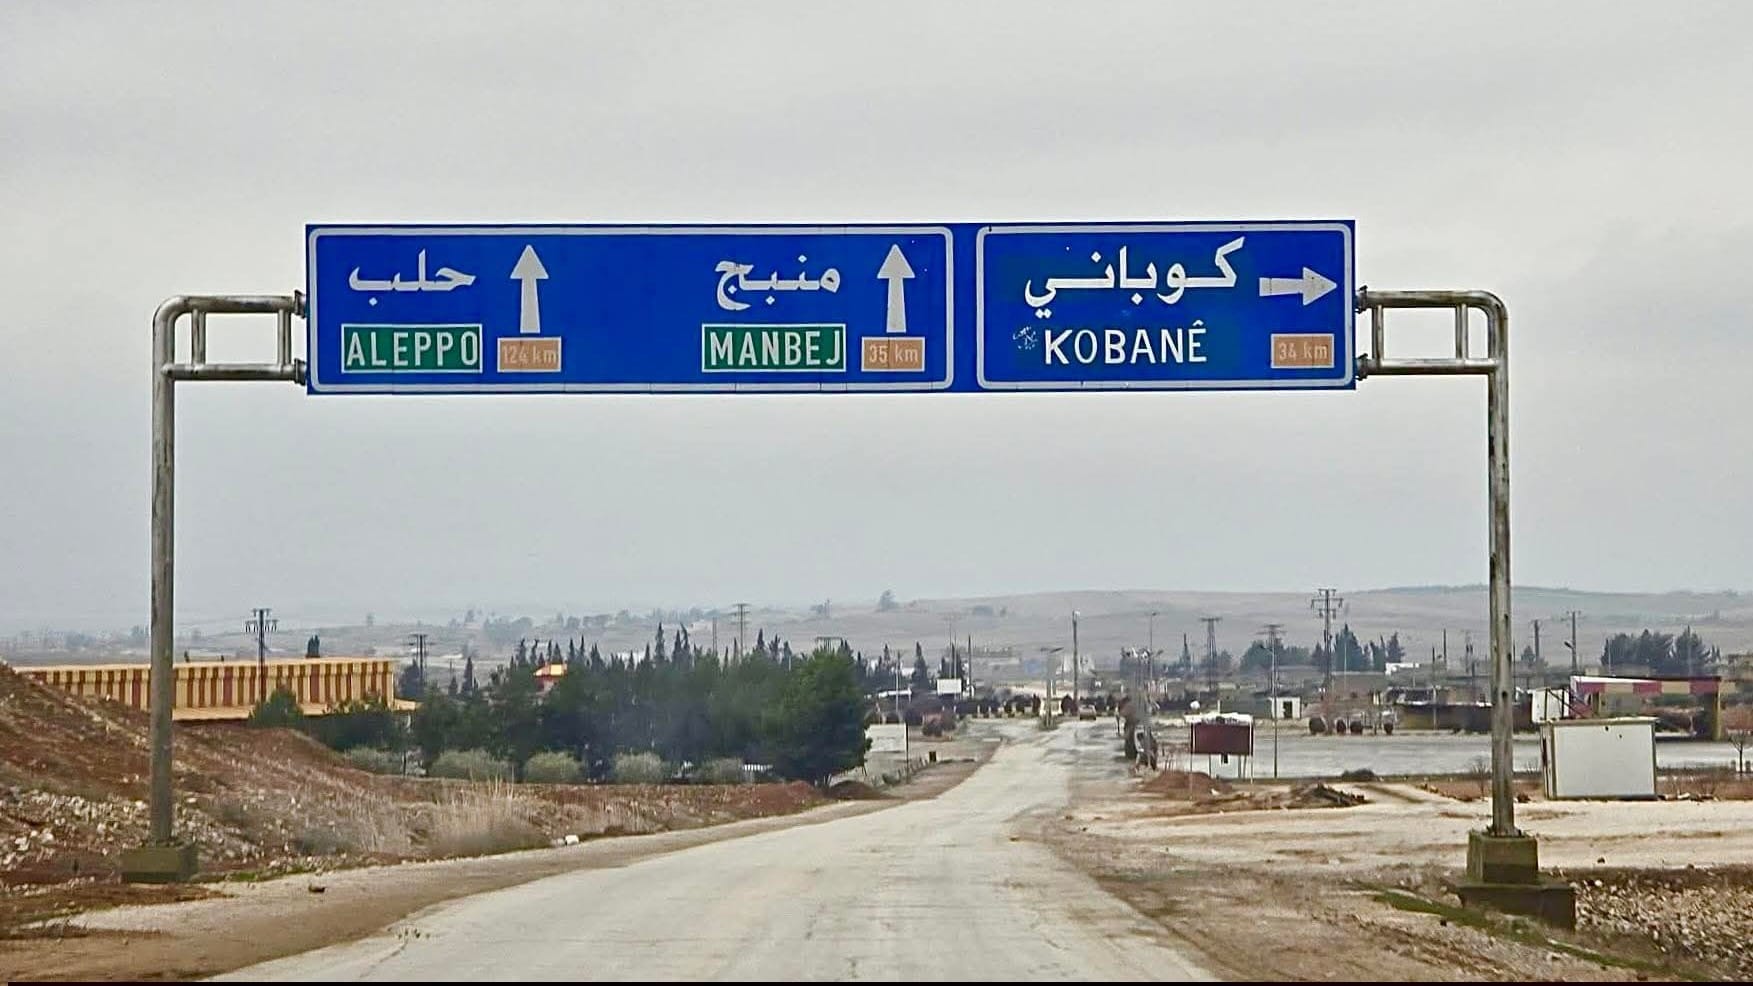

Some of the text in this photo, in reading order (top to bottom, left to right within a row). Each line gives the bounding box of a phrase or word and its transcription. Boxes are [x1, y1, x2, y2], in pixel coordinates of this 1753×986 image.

[349, 249, 476, 305] حلب
[715, 255, 840, 311] منبج
[1024, 236, 1245, 319] كوباني
[346, 331, 477, 367] ALEPPO
[502, 345, 557, 365] 124 km
[710, 331, 841, 366] MANBEJ
[869, 344, 918, 363] 35 km
[1045, 319, 1207, 365] KOBANÊ
[1278, 341, 1328, 361] 34 km
